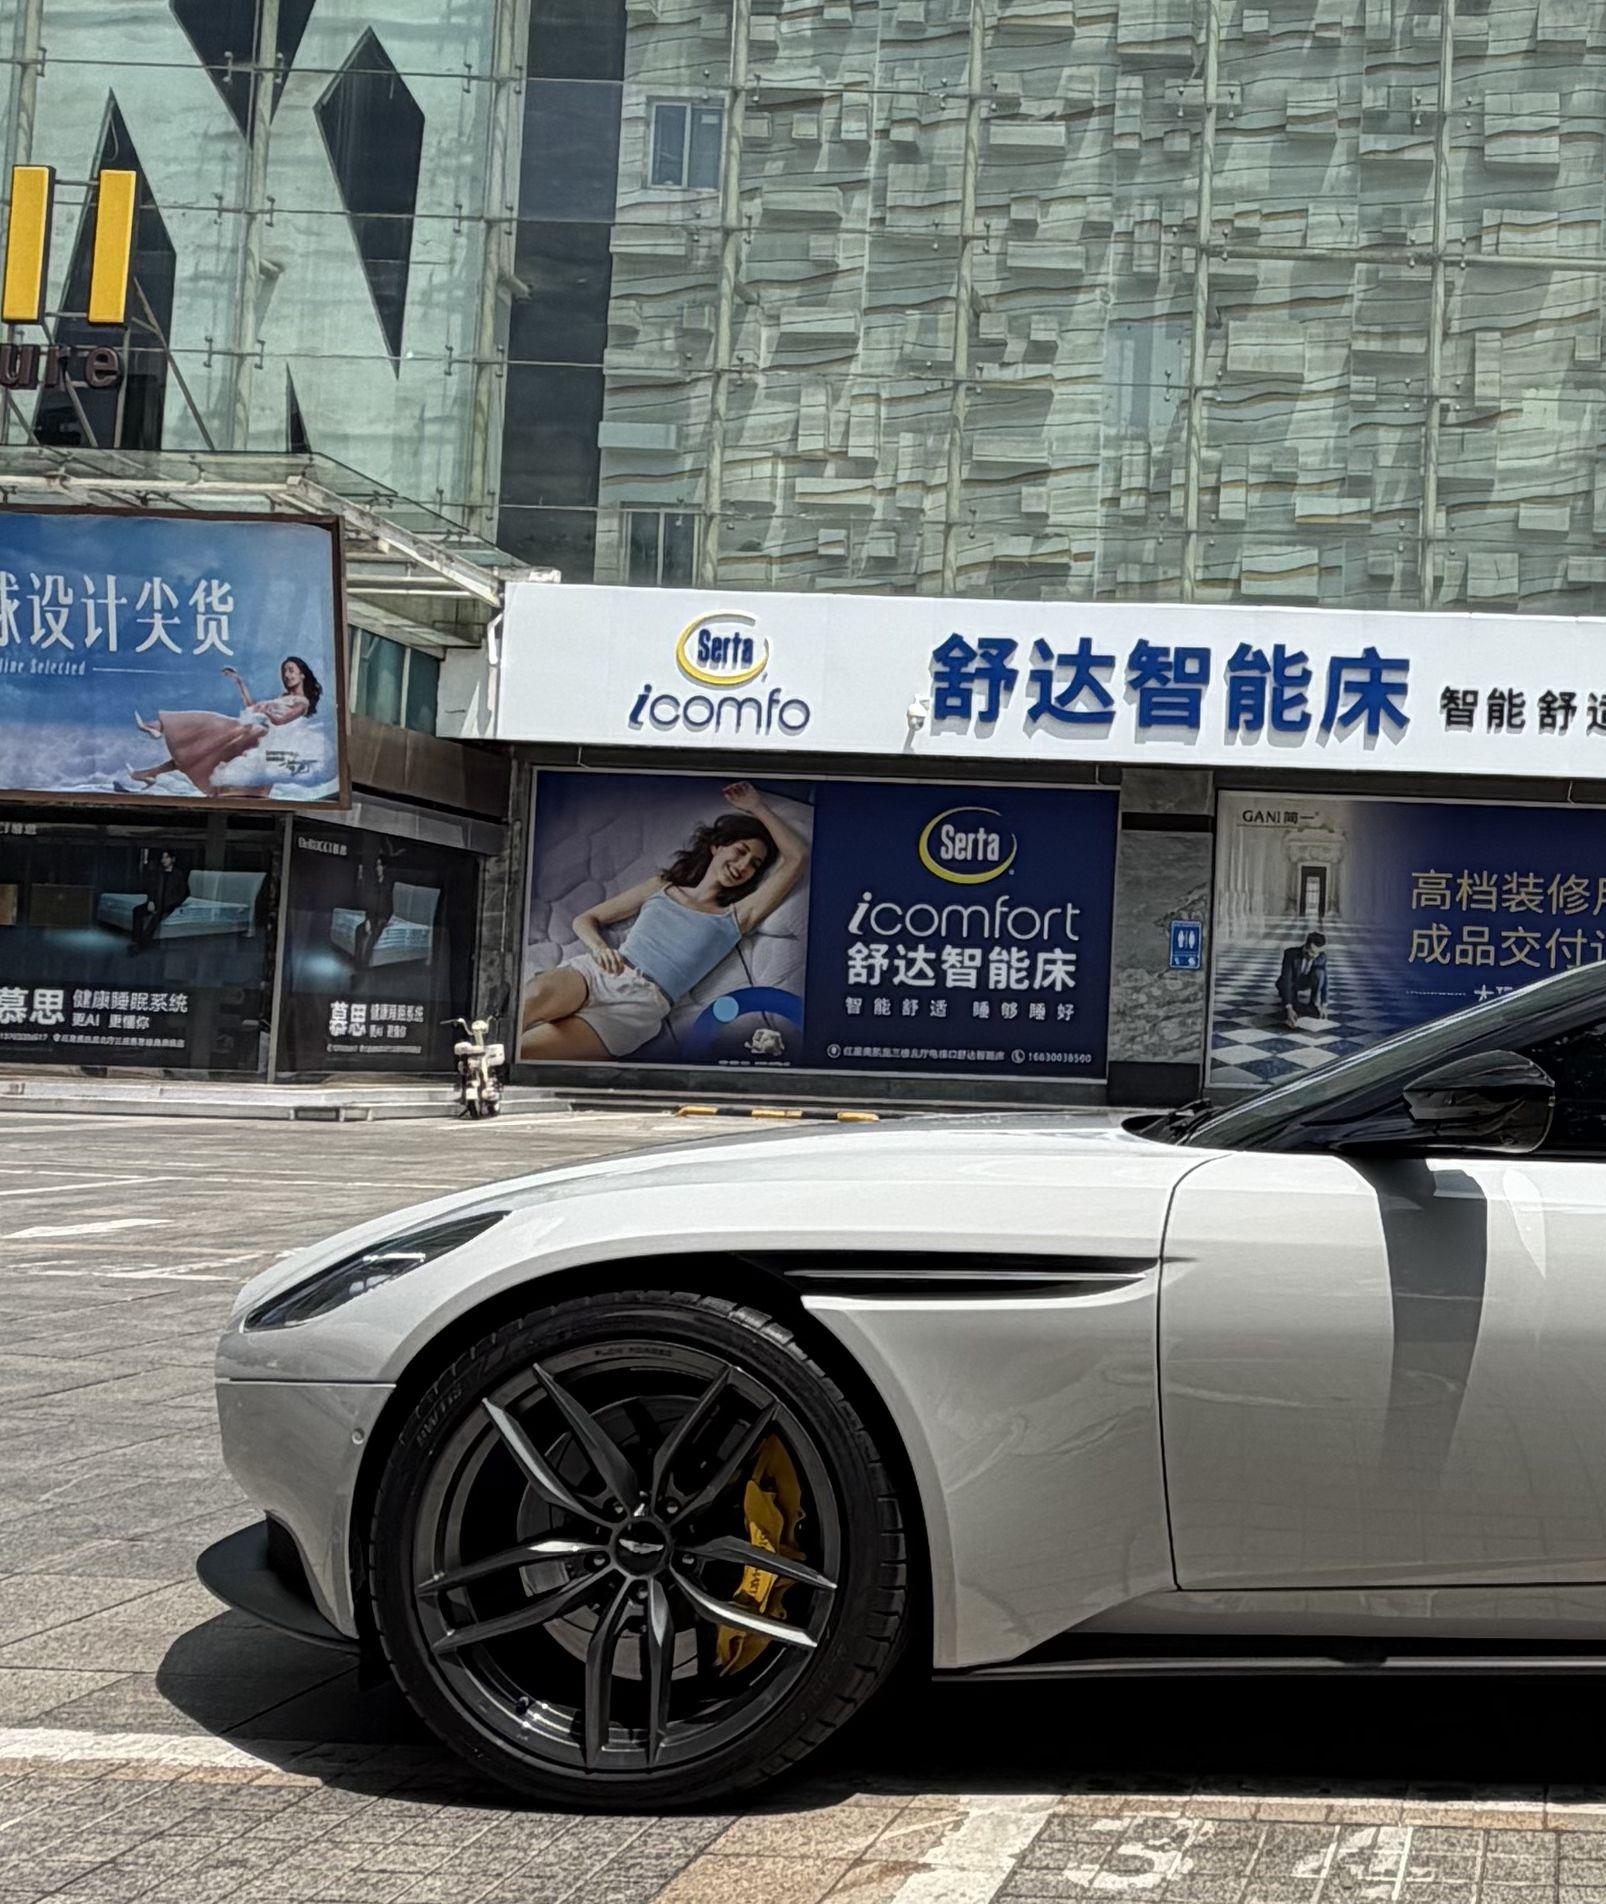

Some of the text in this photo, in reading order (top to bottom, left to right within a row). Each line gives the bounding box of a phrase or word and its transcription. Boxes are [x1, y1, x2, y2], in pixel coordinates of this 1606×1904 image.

[697, 628, 754, 666] Serta
[931, 632, 1411, 738] 舒达智能床
[629, 683, 811, 733] icomfo
[1242, 810, 1280, 824] GANI
[940, 824, 1001, 861] Serta
[848, 891, 1081, 941] icomfort
[847, 941, 1077, 992] 舒达智能床
[0, 987, 65, 1026] 慕思
